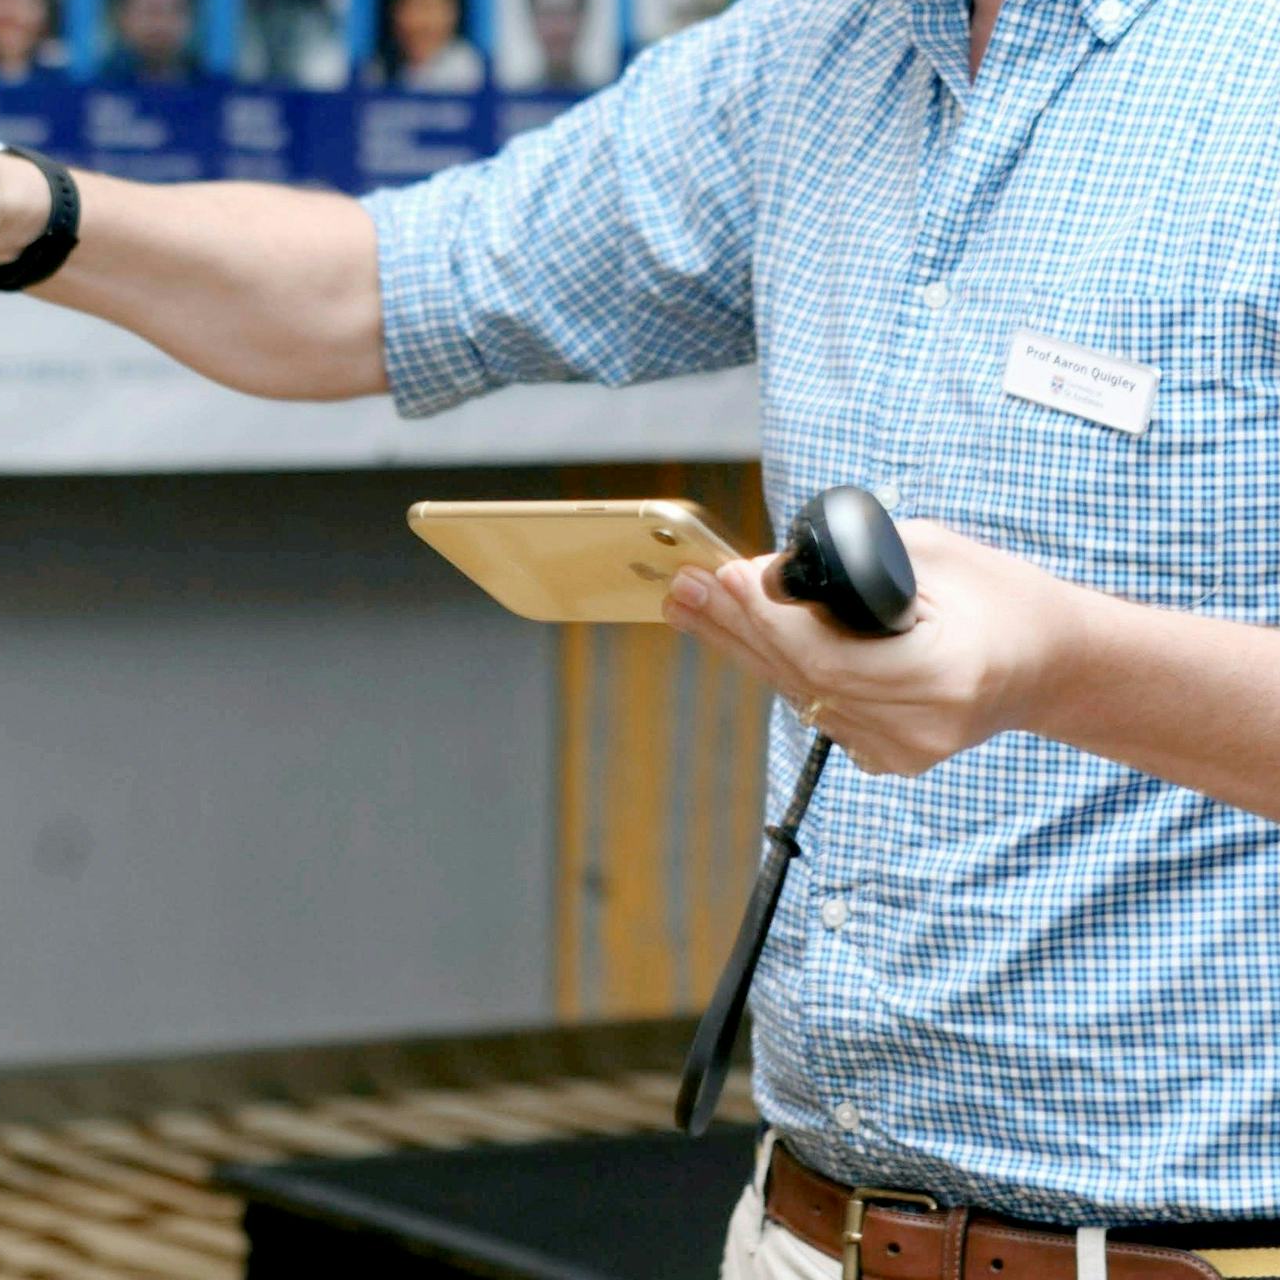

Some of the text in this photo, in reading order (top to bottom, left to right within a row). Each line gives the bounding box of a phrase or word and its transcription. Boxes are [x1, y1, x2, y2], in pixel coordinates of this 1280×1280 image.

[1026, 345, 1137, 393] Prof Aaron Quigley
